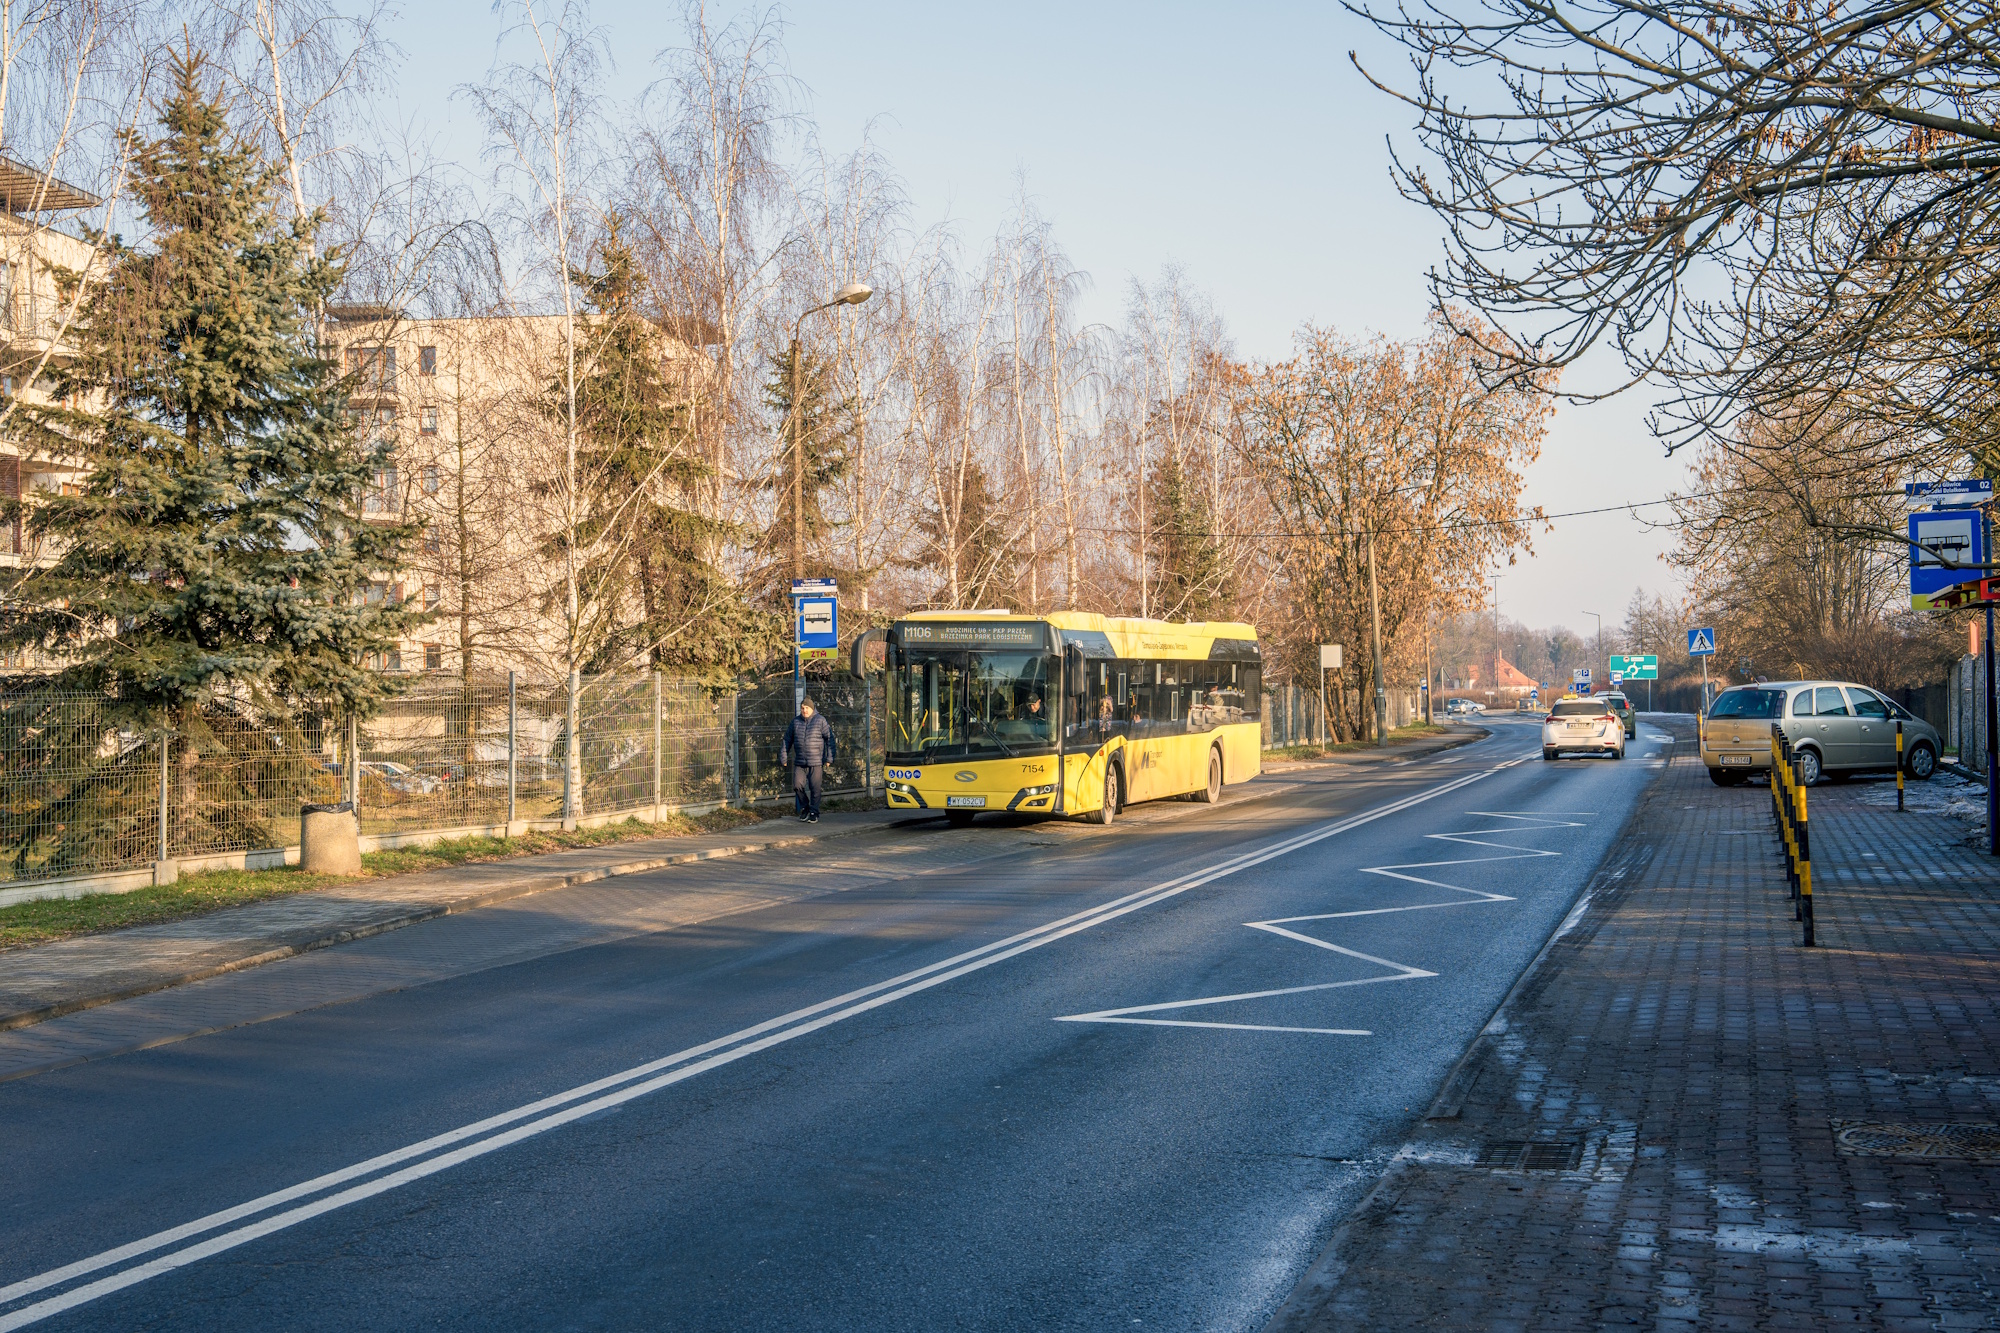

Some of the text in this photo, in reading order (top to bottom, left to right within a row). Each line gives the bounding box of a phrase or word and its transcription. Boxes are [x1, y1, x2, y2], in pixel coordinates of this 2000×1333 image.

[1980, 481, 1990, 489] 02
[904, 626, 932, 638] M106
[810, 650, 827, 658] ZTM
[1021, 764, 1044, 773] 7154
[952, 797, 984, 805] WY 052CV
